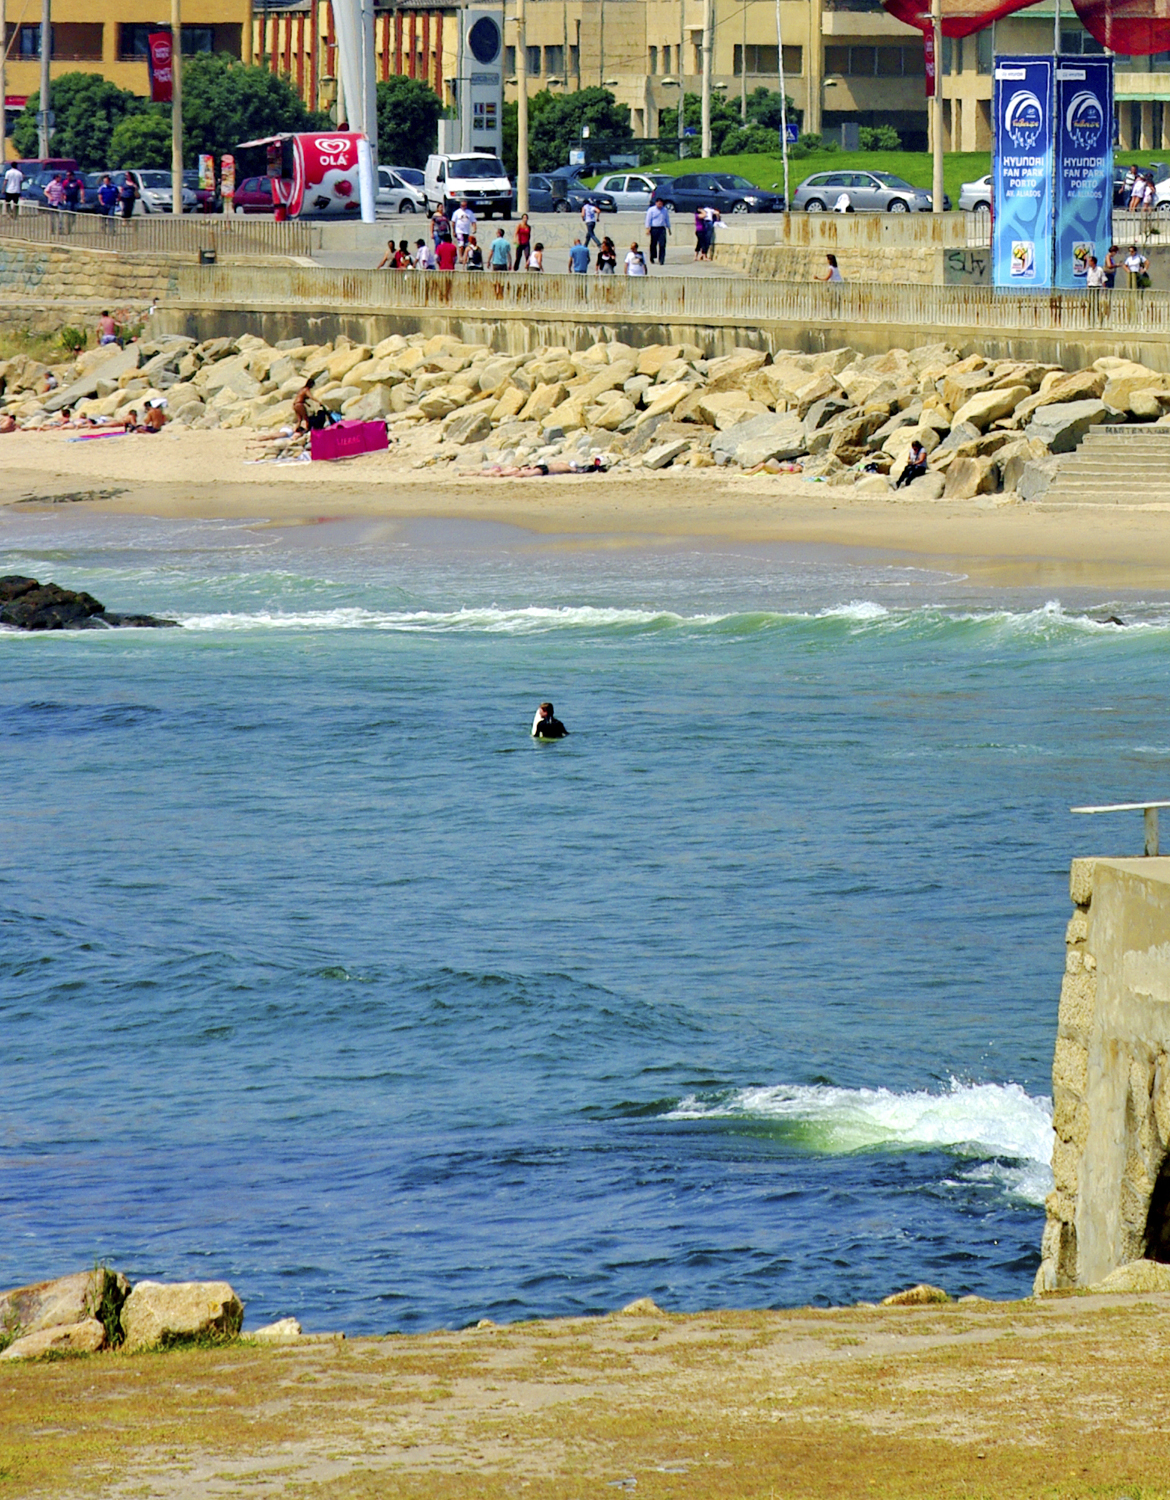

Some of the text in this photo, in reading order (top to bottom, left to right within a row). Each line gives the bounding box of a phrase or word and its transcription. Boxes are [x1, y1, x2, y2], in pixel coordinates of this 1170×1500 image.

[320, 153, 347, 165] OLÁ
[1003, 156, 1044, 167] HYUNDAI
[1063, 157, 1105, 167] HYUNDAI
[1003, 168, 1043, 177] FAN PARK
[1063, 169, 1104, 178] FAN PARK
[1010, 179, 1036, 187] PORTO
[1071, 180, 1097, 188] PORTO
[1078, 190, 1102, 198] ALIADOS
